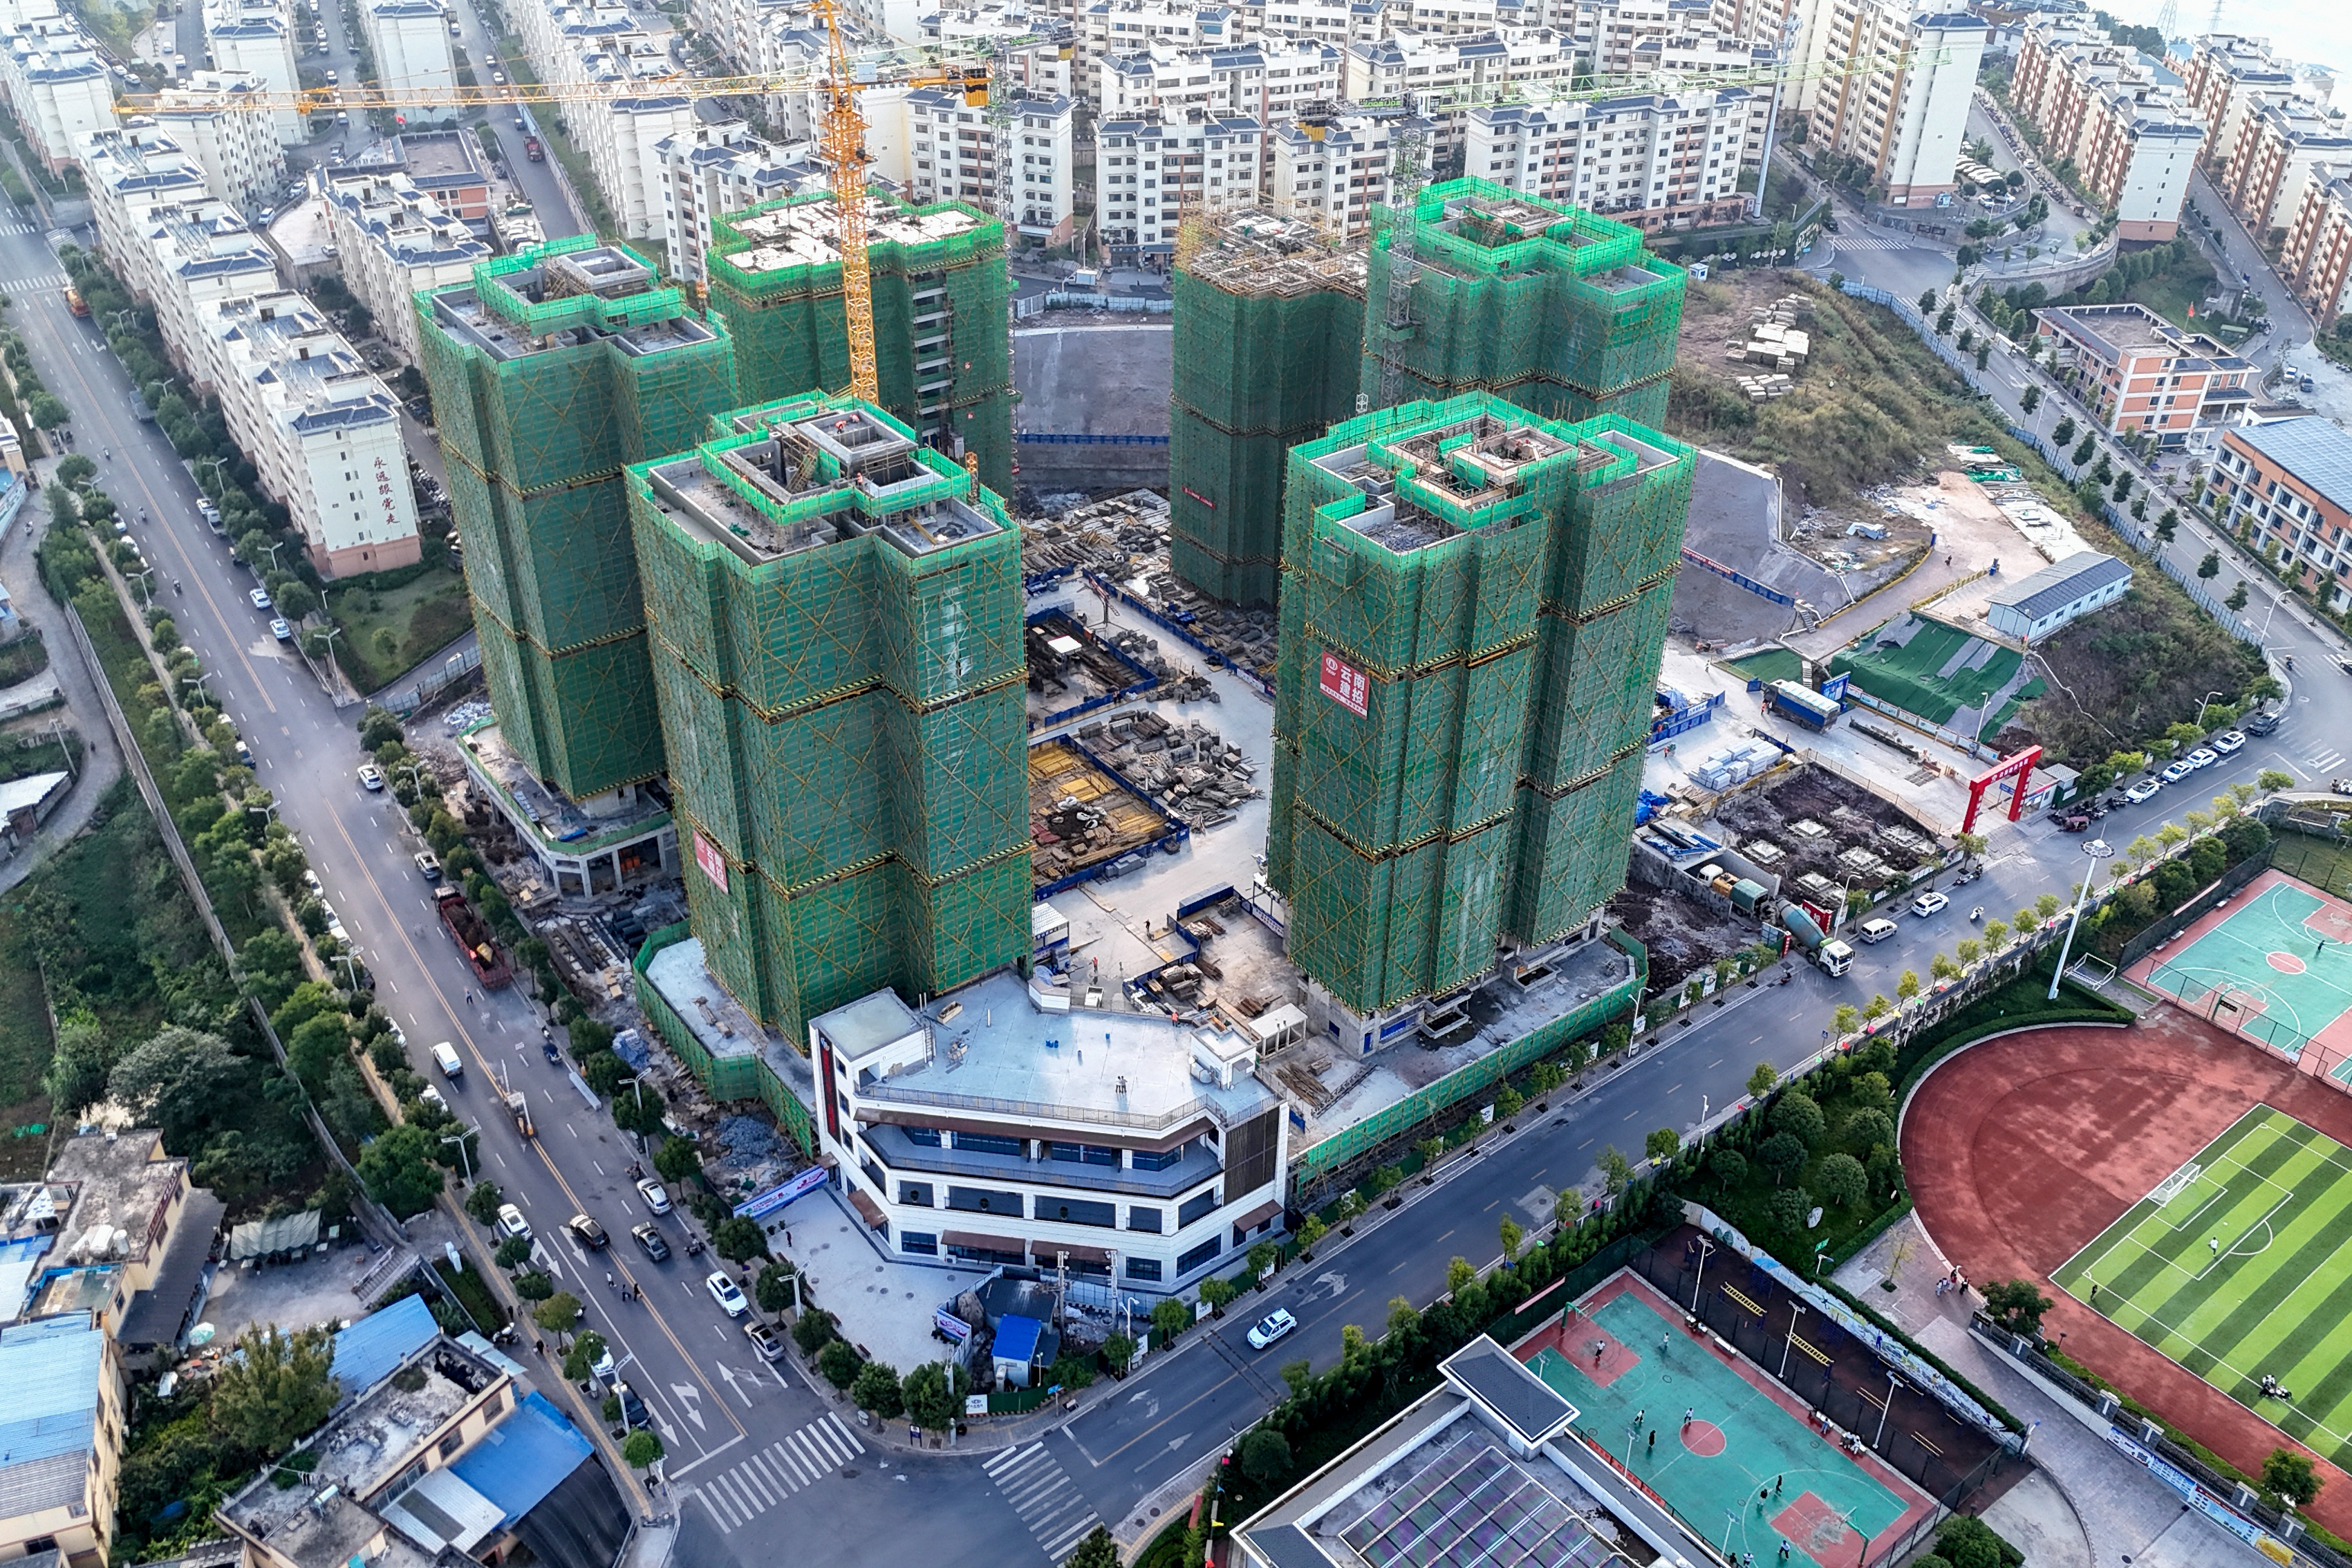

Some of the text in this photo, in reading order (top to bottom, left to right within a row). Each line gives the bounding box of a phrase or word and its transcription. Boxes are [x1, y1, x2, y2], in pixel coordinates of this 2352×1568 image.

[374, 457, 400, 525] 永远跟党走
[1341, 666, 1365, 691] 云南
[1340, 680, 1364, 706] 建投
